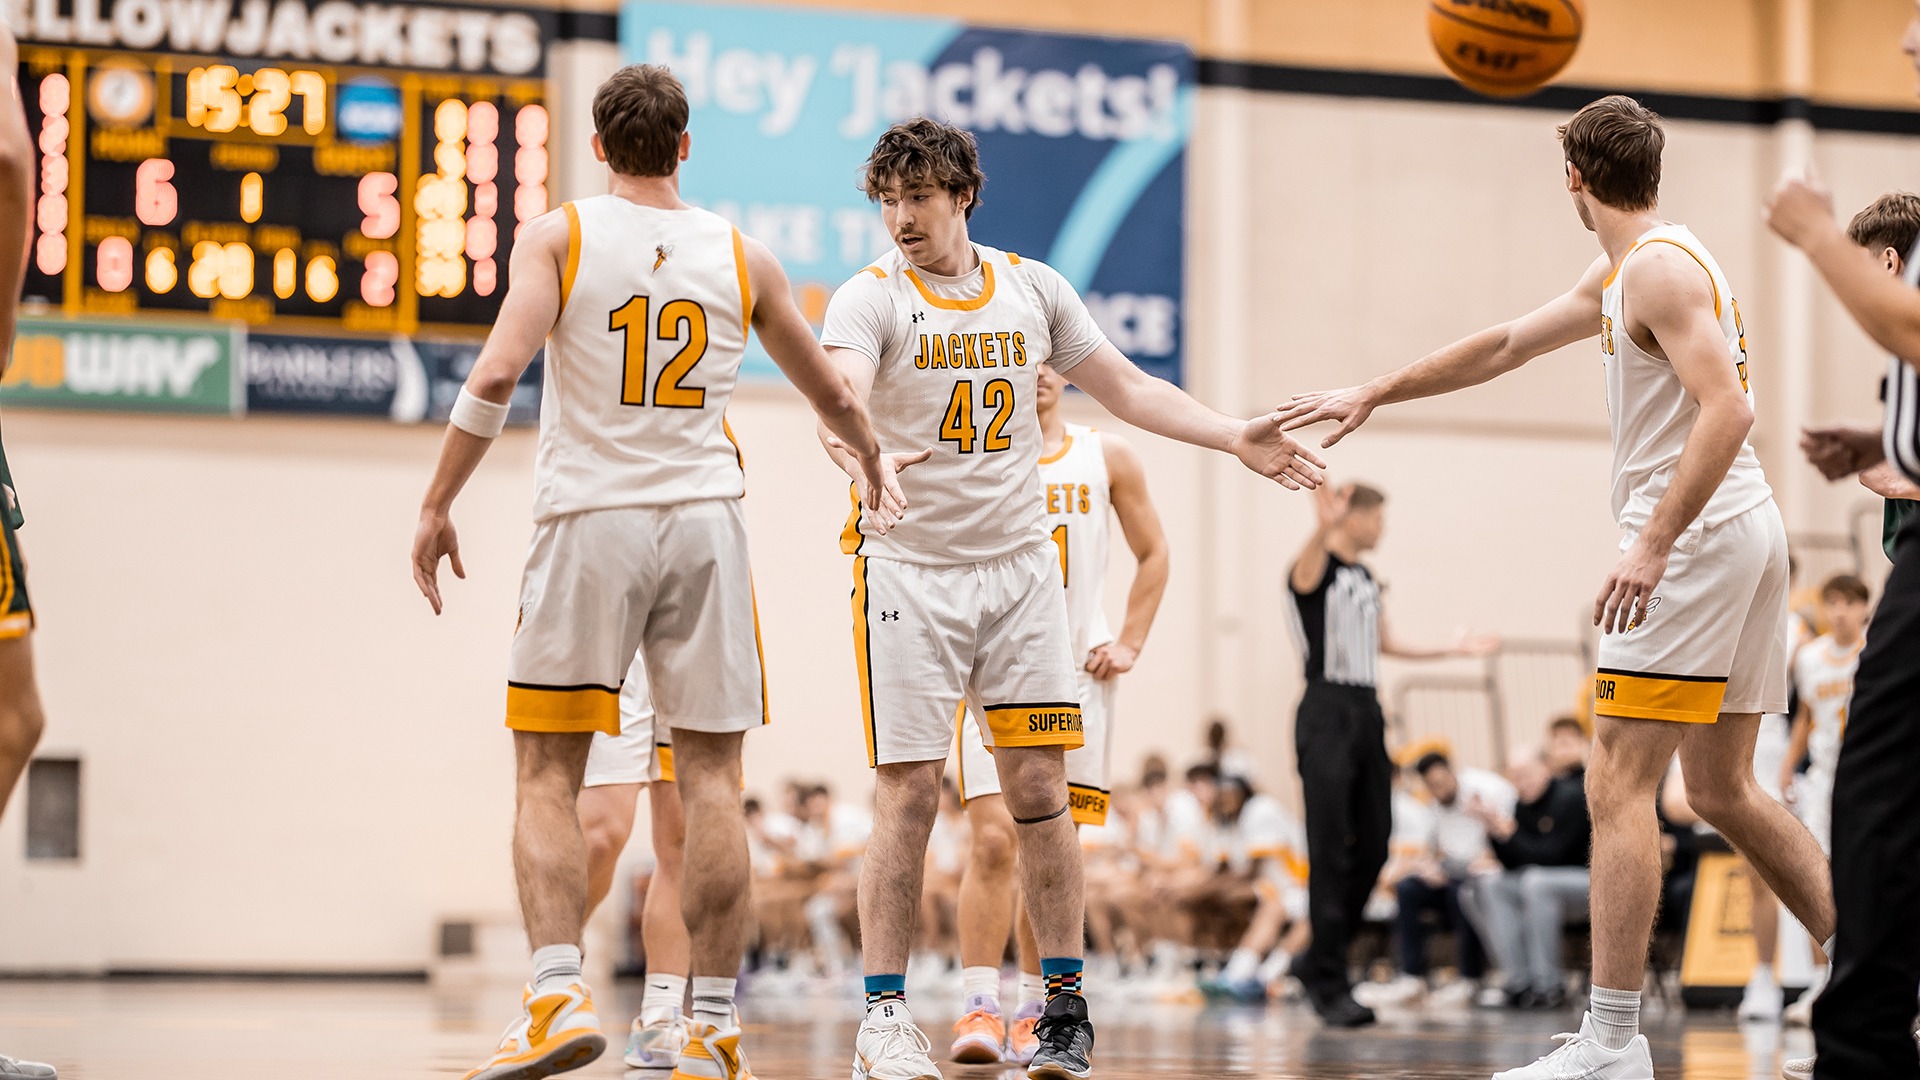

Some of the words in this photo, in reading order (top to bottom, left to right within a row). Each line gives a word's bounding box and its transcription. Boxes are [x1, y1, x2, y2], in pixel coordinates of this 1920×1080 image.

[186, 64, 326, 136] 15:27
[648, 28, 817, 137] Hey
[135, 158, 178, 226] 6
[358, 171, 401, 239] 5
[608, 294, 709, 409] 12
[914, 331, 1027, 369] JACKETS
[939, 378, 1015, 455] 42
[1046, 483, 1090, 514] ETS
[1028, 712, 1084, 732] SUPERIOR
